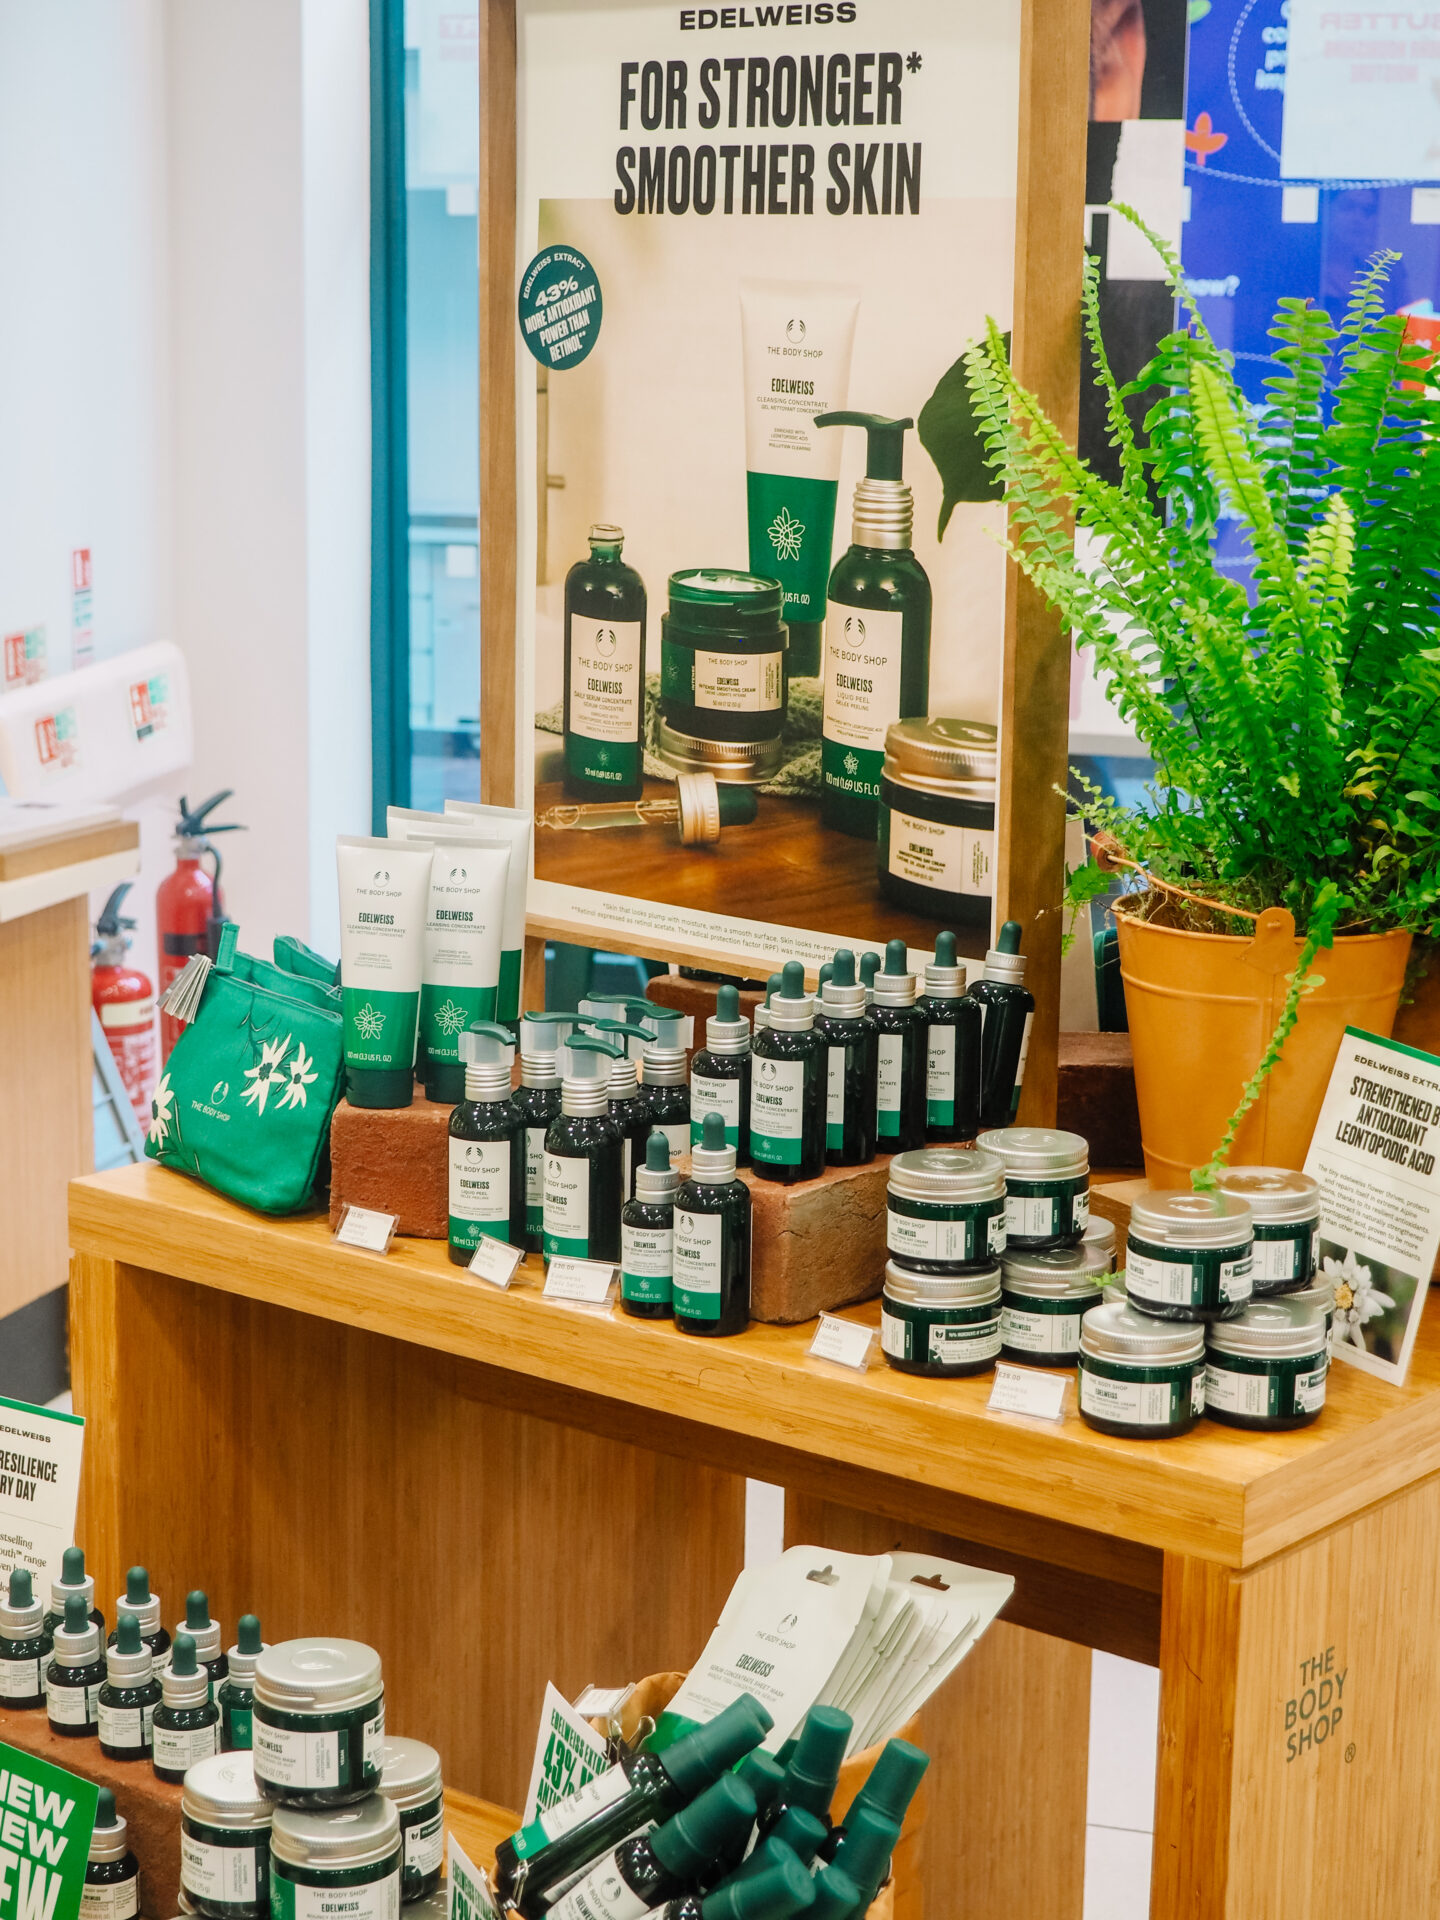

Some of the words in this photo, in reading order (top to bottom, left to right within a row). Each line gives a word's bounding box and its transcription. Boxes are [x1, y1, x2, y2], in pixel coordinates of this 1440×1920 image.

[680, 2, 857, 31] EDELWEISS
[619, 60, 688, 131] FOR
[614, 144, 815, 216] SMOOTHER
[826, 142, 923, 216] SKIN
[523, 256, 551, 299] EDELWEISS
[554, 253, 586, 271] EXTRACT
[535, 275, 579, 307] 43%
[524, 309, 547, 334] MORE
[546, 285, 596, 324] ANTIOXIDANT
[539, 319, 569, 347] POWER
[567, 308, 590, 332] THAN
[767, 346, 780, 355] THE
[782, 347, 801, 357] BODY
[803, 349, 823, 358] SHOP
[771, 378, 814, 396] EDELWEISS
[757, 396, 787, 405] CLEANSING
[788, 398, 828, 408] CONCENTRATE
[578, 656, 590, 669] THE
[593, 659, 613, 672] BODY
[614, 662, 633, 673] SHOP
[720, 658, 733, 666] BODY
[734, 659, 748, 667] SHOP
[829, 646, 840, 659] THE
[841, 650, 862, 663] BODY
[864, 654, 888, 667] SHOP
[587, 678, 623, 695] EDELWEISS
[716, 676, 739, 687] EDELWEISS
[836, 673, 873, 693] EDELWEISS
[836, 692, 854, 703] LIQUID
[855, 696, 870, 704] PEEL
[356, 888, 367, 896] THE
[369, 889, 384, 897] BODY
[386, 890, 402, 898] SHOP
[432, 885, 444, 893] THE
[446, 886, 461, 894] BODY
[358, 912, 394, 925] EDELWEISS
[436, 910, 473, 921] EDELWEISS
[372, 926, 406, 934] CONCENTRATE
[597, 910, 625, 923] expressed
[634, 917, 653, 929] retinol
[678, 925, 688, 935] The
[689, 927, 709, 940] radical
[710, 932, 741, 946] protection
[742, 937, 761, 949] factor
[781, 947, 793, 956] was
[794, 948, 826, 961] measured
[619, 905, 631, 913] that
[632, 907, 647, 917] looks
[648, 910, 666, 922] plump
[667, 914, 680, 923] with
[709, 922, 723, 932] with
[729, 927, 753, 939] smooth
[780, 935, 794, 946] Skin
[795, 939, 812, 950] looks
[1354, 1054, 1410, 1080] EDELWEISS
[1412, 1075, 1440, 1092] EXTR
[697, 1089, 717, 1098] EDELWEISS
[759, 1082, 774, 1091] BODY
[775, 1085, 794, 1093] SHOP
[756, 1093, 783, 1106] EDELWEISS
[1350, 1076, 1432, 1123] STRENGTHENED
[1431, 1105, 1440, 1128] B
[191, 1100, 203, 1111] THE
[202, 1105, 217, 1117] BODY
[216, 1111, 231, 1122] SHOP
[1356, 1103, 1428, 1146] ANTIOXIDANT
[1335, 1120, 1410, 1166] LEONTOPODIC
[1407, 1148, 1436, 1176] ACID
[464, 1166, 481, 1174] BODY
[482, 1167, 500, 1175] SHOP
[460, 1179, 490, 1190] EDELWEISS
[561, 1182, 578, 1190] SHOP
[1318, 1163, 1328, 1172] The
[1367, 1183, 1385, 1196] flower
[1406, 1200, 1430, 1214] protects
[545, 1192, 567, 1206] EDELWEISS
[1324, 1178, 1334, 1187] and
[1336, 1182, 1354, 1195] repairs
[1355, 1189, 1370, 1201] itself
[1376, 1198, 1399, 1211] extreme
[1400, 1207, 1418, 1219] Alpine
[1337, 1192, 1356, 1204] thanks
[911, 1222, 926, 1230] SHOP
[1325, 1217, 1338, 1227] than
[1338, 1222, 1353, 1233] other
[1335, 1202, 1355, 1215] extract
[1362, 1212, 1386, 1227] naturally
[1387, 1223, 1424, 1242] strengthened
[633, 1241, 656, 1249] EDELWEISS
[693, 1238, 712, 1246] SHOP
[1367, 1225, 1387, 1237] proven
[1395, 1235, 1403, 1244] be
[1403, 1240, 1419, 1250] more
[676, 1246, 701, 1260] EDELWEISS
[1010, 1321, 1031, 1332] EDELWEISS
[1095, 1388, 1118, 1400] EDELWEISS
[1111, 1383, 1128, 1391] SHOP
[15, 1481, 37, 1502] DAY
[0, 1534, 33, 1550] stselling
[23, 1555, 47, 1568] range
[764, 1633, 779, 1645] BODY
[779, 1638, 796, 1650] SHOP
[735, 1653, 775, 1678] EDELWEISS
[1299, 1645, 1335, 1686] THE
[753, 1678, 770, 1692] SHEET
[1285, 1667, 1348, 1731] BODY
[274, 1731, 291, 1741] SHOP
[551, 1708, 585, 1758] EDELWEISS
[1286, 1706, 1343, 1763] SHOP
[543, 1731, 577, 1797] 43%
[0, 1806, 69, 1867] EW
[313, 1891, 326, 1899] THE
[349, 1889, 368, 1897] SHOP
[321, 1902, 359, 1913] EDELWEISS
